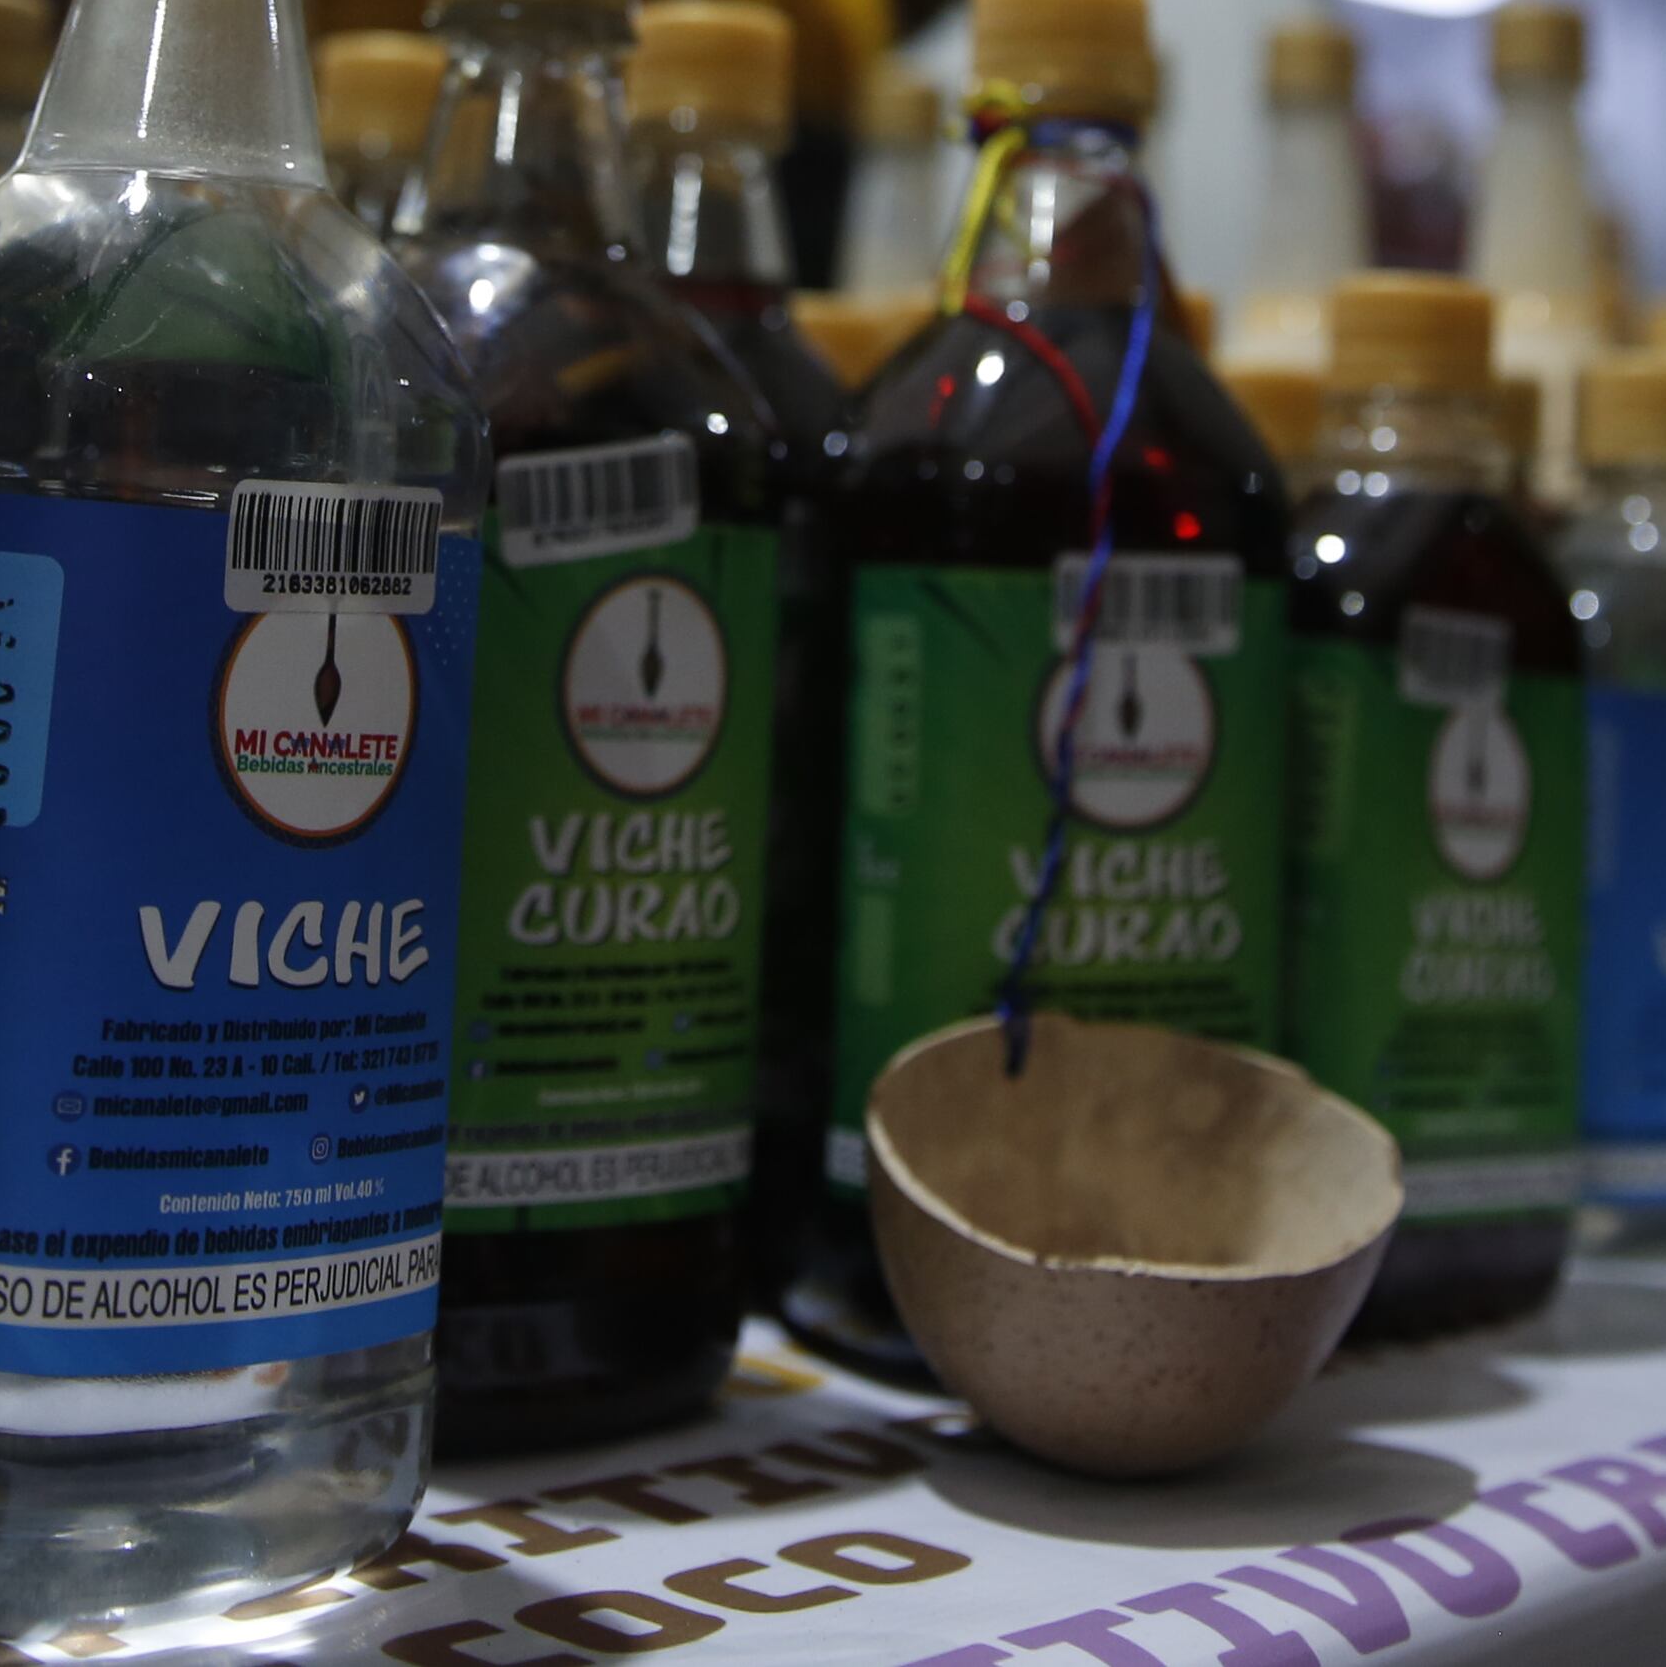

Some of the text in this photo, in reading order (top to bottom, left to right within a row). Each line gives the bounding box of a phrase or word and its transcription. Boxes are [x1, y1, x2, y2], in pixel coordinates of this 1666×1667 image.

[235, 728, 399, 761] MI CANALETE
[236, 754, 394, 777] Bebidas Ancestrales
[527, 807, 733, 876] VICHE
[1008, 837, 1231, 901] VICHE
[507, 875, 742, 947] CURAO
[990, 901, 1244, 967] CURAO
[137, 897, 431, 991] VICHE
[101, 1018, 200, 1044] Fabricado
[206, 1021, 219, 1046] y
[222, 1013, 316, 1041] Distribuido
[319, 1013, 351, 1041] por:
[353, 1010, 372, 1035] Mi
[72, 1054, 125, 1079] Calle
[130, 1054, 164, 1079] 100
[168, 1055, 198, 1078] No.
[202, 1054, 229, 1078] 23
[231, 1054, 244, 1077] A
[260, 1053, 279, 1077] 10
[282, 1051, 317, 1075] Cali.
[360, 1047, 386, 1071] 321
[93, 1090, 309, 1119] micanalete@gmail.com
[88, 1143, 270, 1172] Bebidasmicanalete
[158, 1194, 240, 1215] Contenido
[243, 1190, 282, 1212] Neto:
[285, 1186, 313, 1208] 750
[44, 1227, 66, 1259] el
[71, 1227, 169, 1263] expendio
[174, 1227, 200, 1257] de
[204, 1221, 279, 1255] bebidas
[283, 1209, 390, 1250] embriagantes
[41, 1279, 84, 1321] DE
[89, 1273, 226, 1321] ALCOHOL
[233, 1273, 267, 1313] ES
[272, 1251, 404, 1310] PERJUDICIAL
[380, 1530, 973, 1667] COCO
